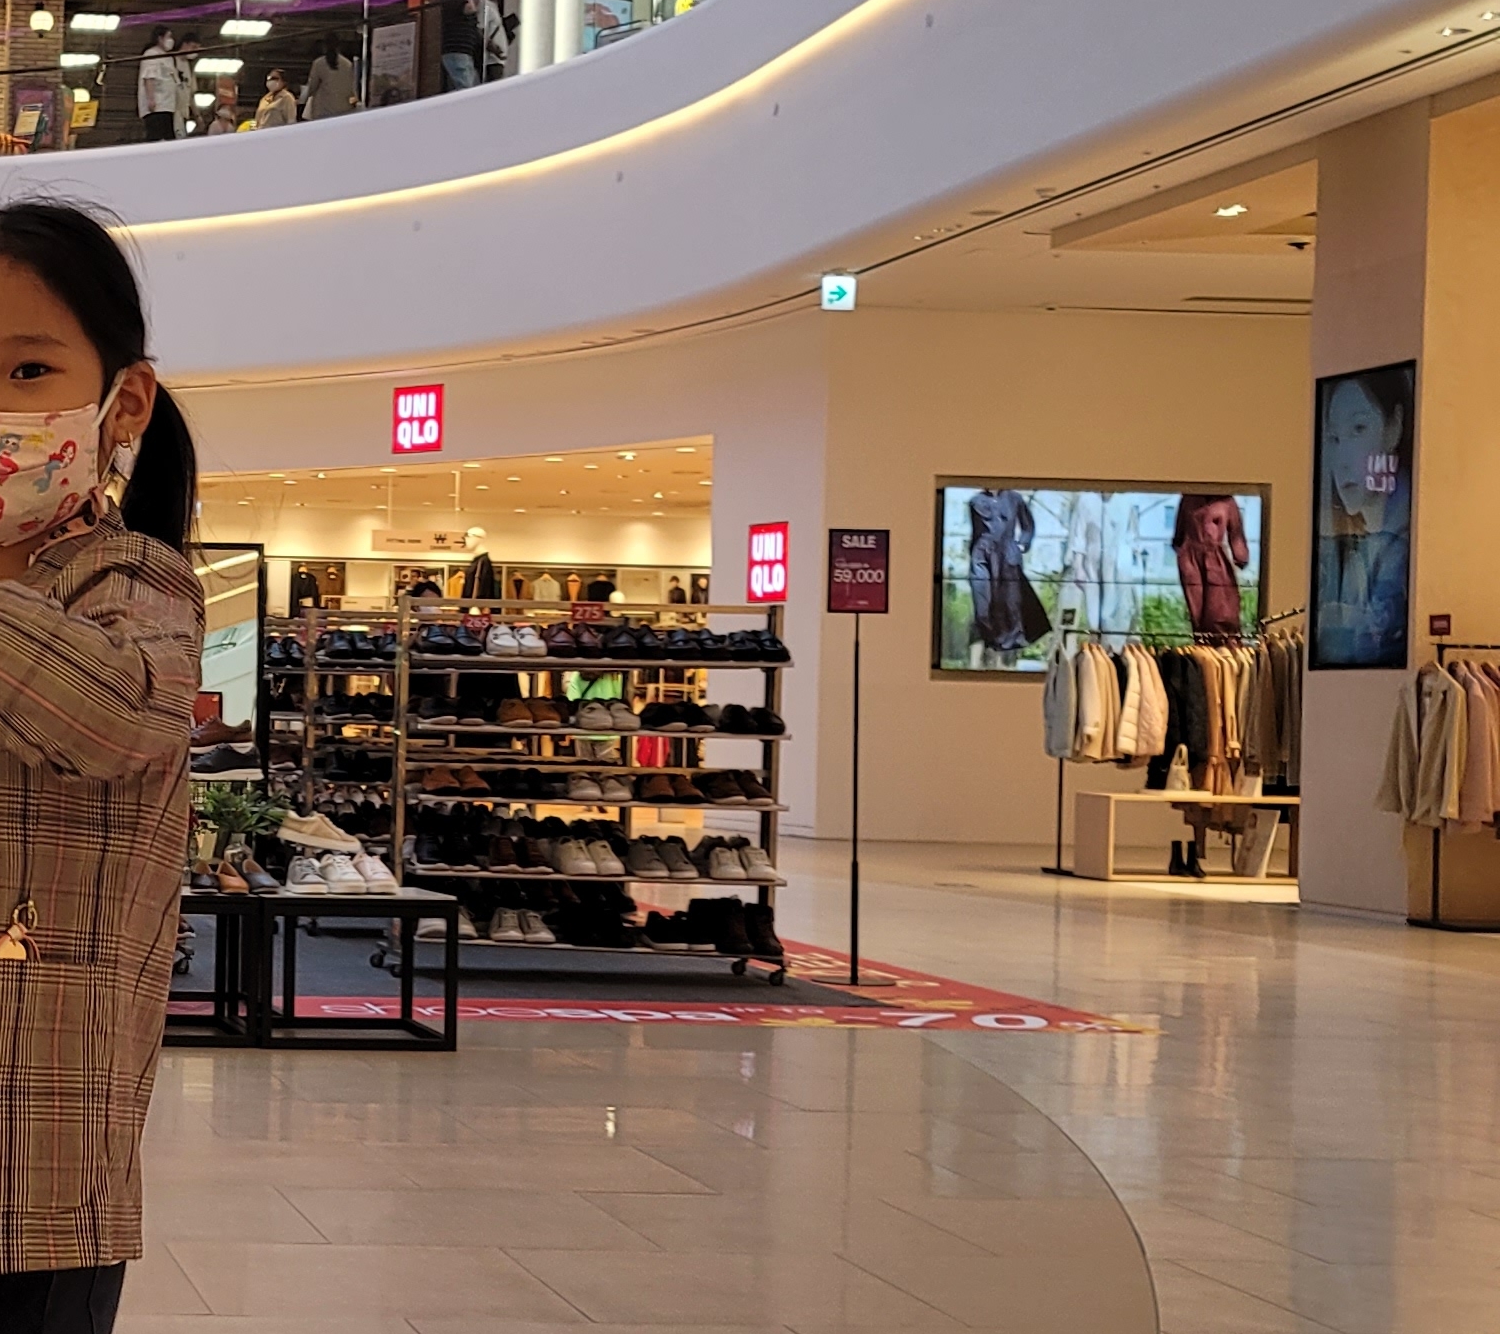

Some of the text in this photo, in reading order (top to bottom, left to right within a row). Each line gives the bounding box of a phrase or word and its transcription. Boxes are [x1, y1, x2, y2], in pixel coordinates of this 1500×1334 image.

[398, 392, 436, 419] UNI
[397, 418, 439, 449] QLO
[752, 531, 783, 562] UNI
[841, 534, 877, 549] SALE
[750, 563, 785, 598] QLO
[466, 617, 490, 628] 265
[574, 605, 602, 618] 275
